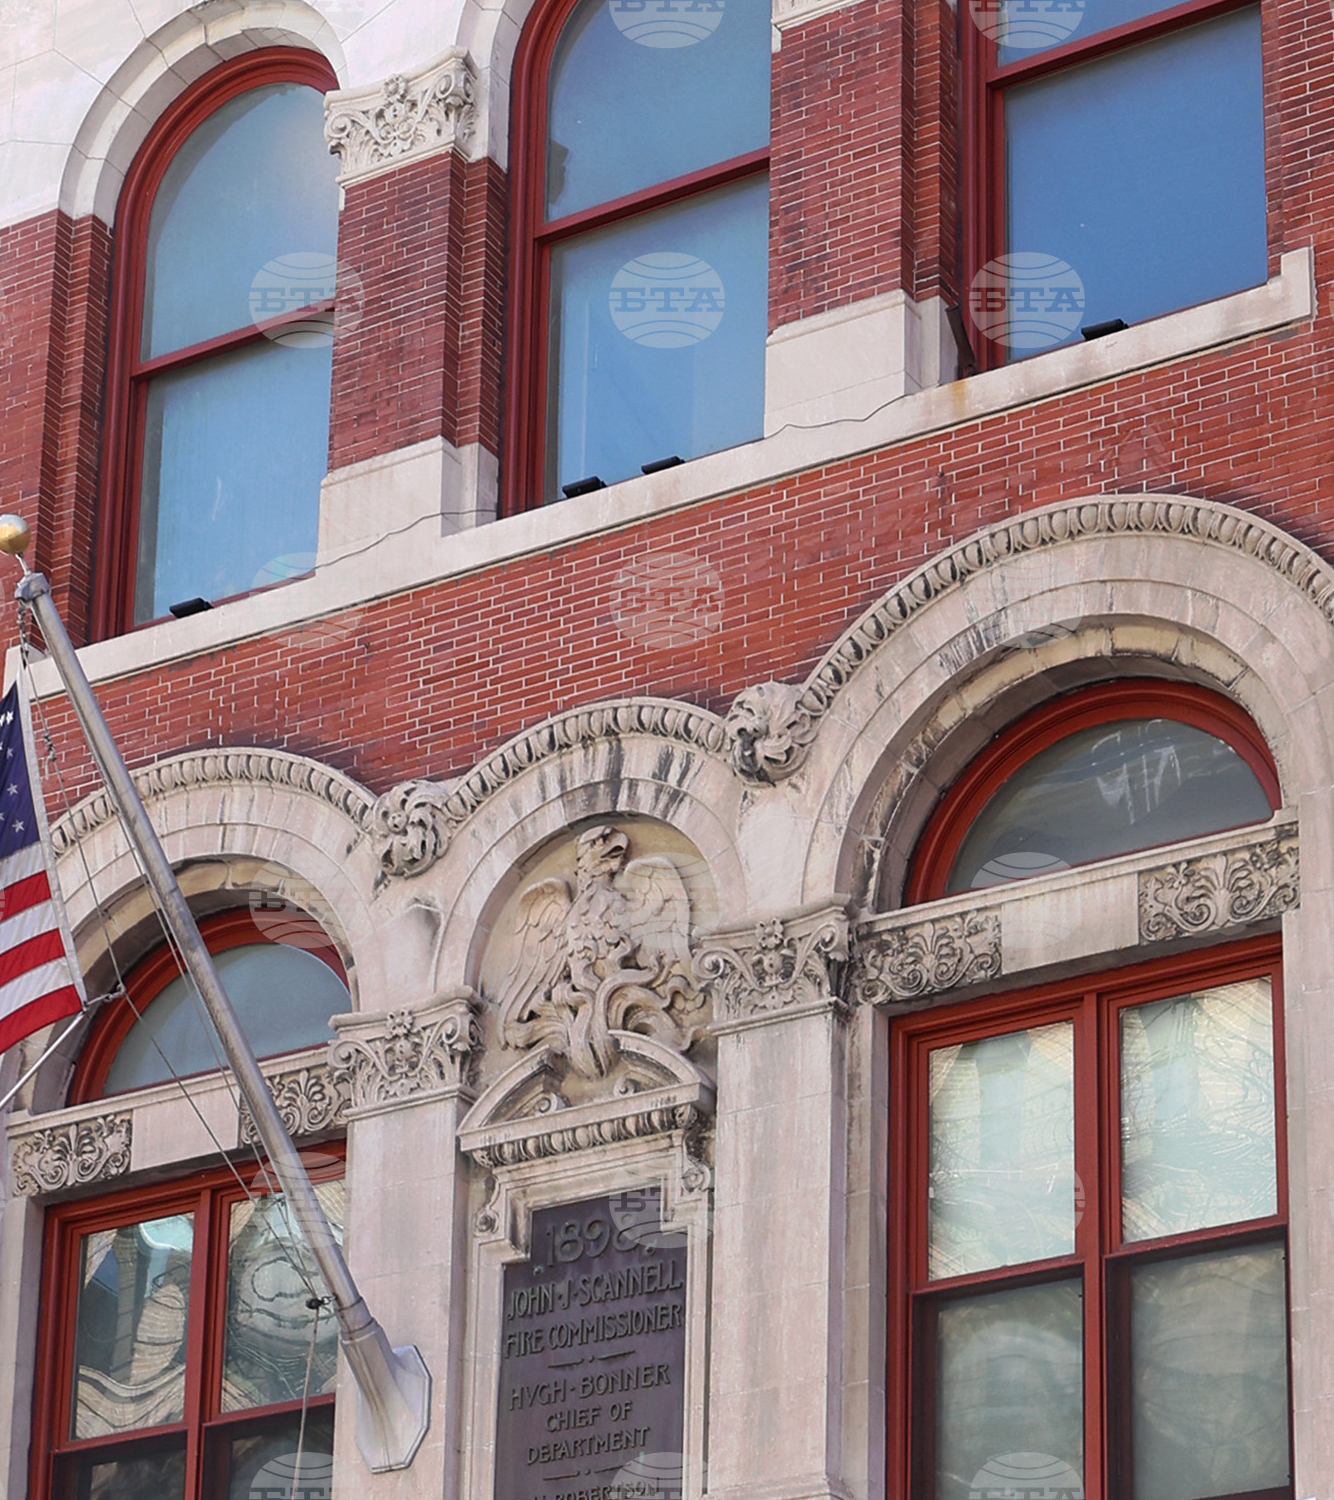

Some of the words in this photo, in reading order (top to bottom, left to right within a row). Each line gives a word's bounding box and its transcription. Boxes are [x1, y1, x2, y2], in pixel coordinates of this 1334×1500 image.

[506, 1285, 555, 1322] JOHN
[579, 1260, 683, 1308] SCANNELL
[504, 1323, 545, 1360] FIRE
[547, 1302, 684, 1350] COMMISSIONER
[580, 1361, 671, 1398] BONNER
[545, 1404, 602, 1433] CHIEF
[609, 1399, 633, 1424] OF
[526, 1425, 651, 1466] DEPARTMENT
